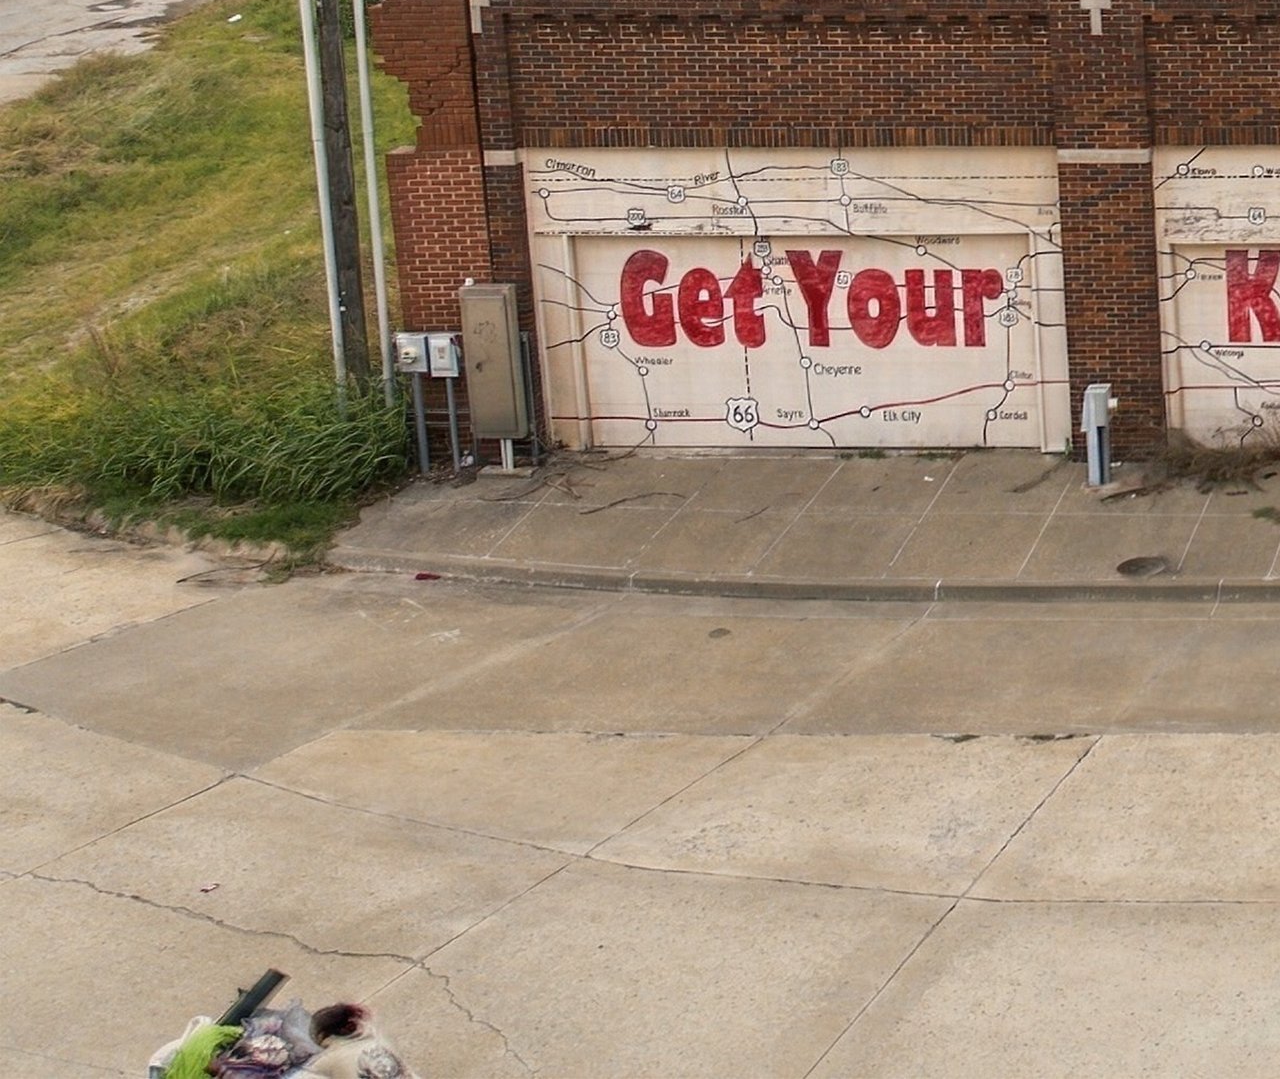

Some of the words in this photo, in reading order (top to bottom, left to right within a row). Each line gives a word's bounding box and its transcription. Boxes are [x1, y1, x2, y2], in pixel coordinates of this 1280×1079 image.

[670, 188, 682, 199] 64
[620, 249, 767, 349] Get
[786, 249, 1001, 349] Your
[604, 332, 616, 344] 83
[733, 405, 754, 423] 66
